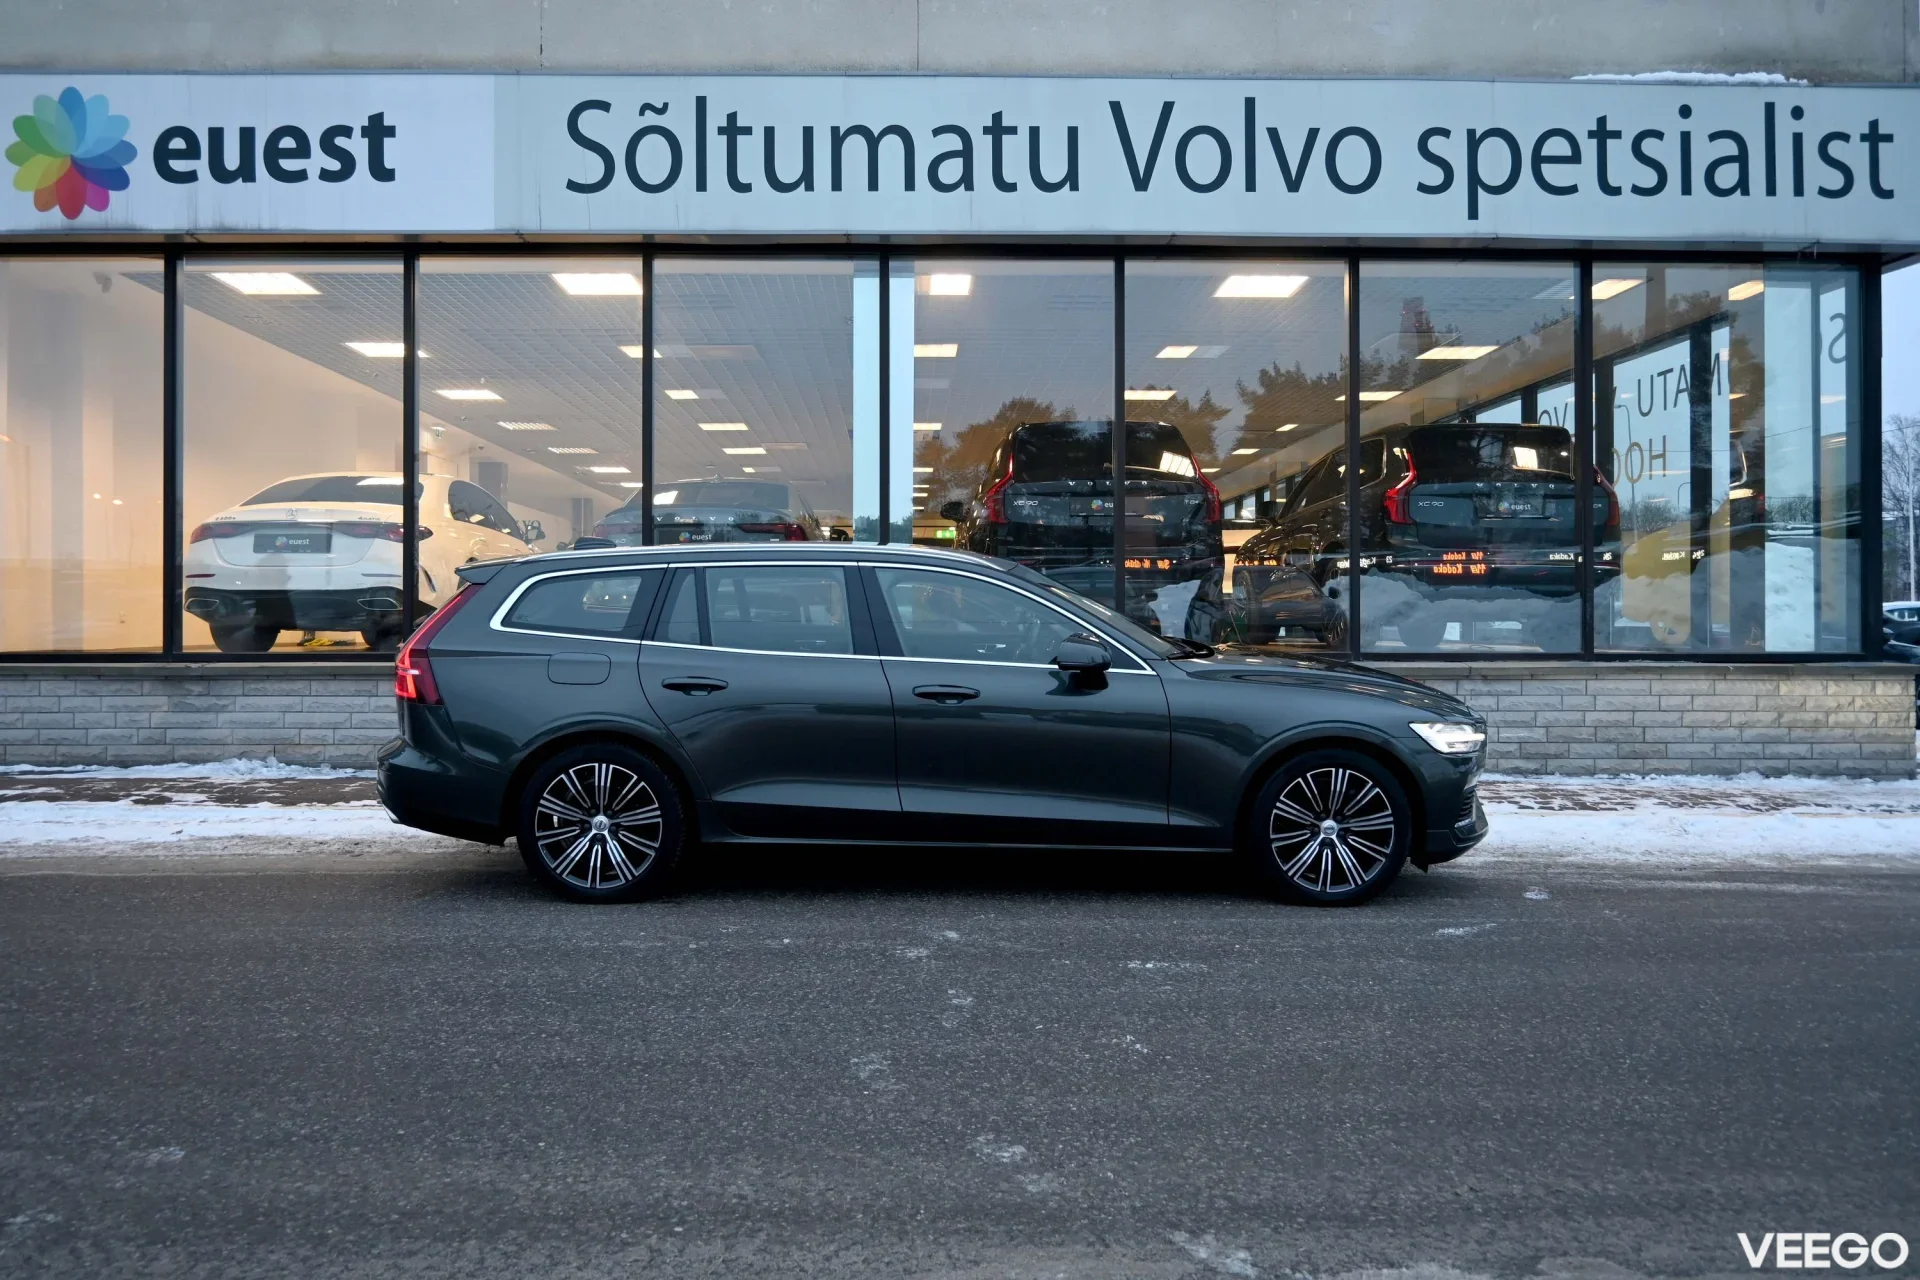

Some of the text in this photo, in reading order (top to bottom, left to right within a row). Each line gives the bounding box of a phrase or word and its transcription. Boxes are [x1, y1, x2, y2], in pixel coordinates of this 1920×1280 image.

[152, 111, 397, 185] euest
[565, 95, 1895, 221] Sõltumatu Volvo spetsialist
[655, 515, 735, 523] VOLVO
[691, 533, 712, 541] euest
